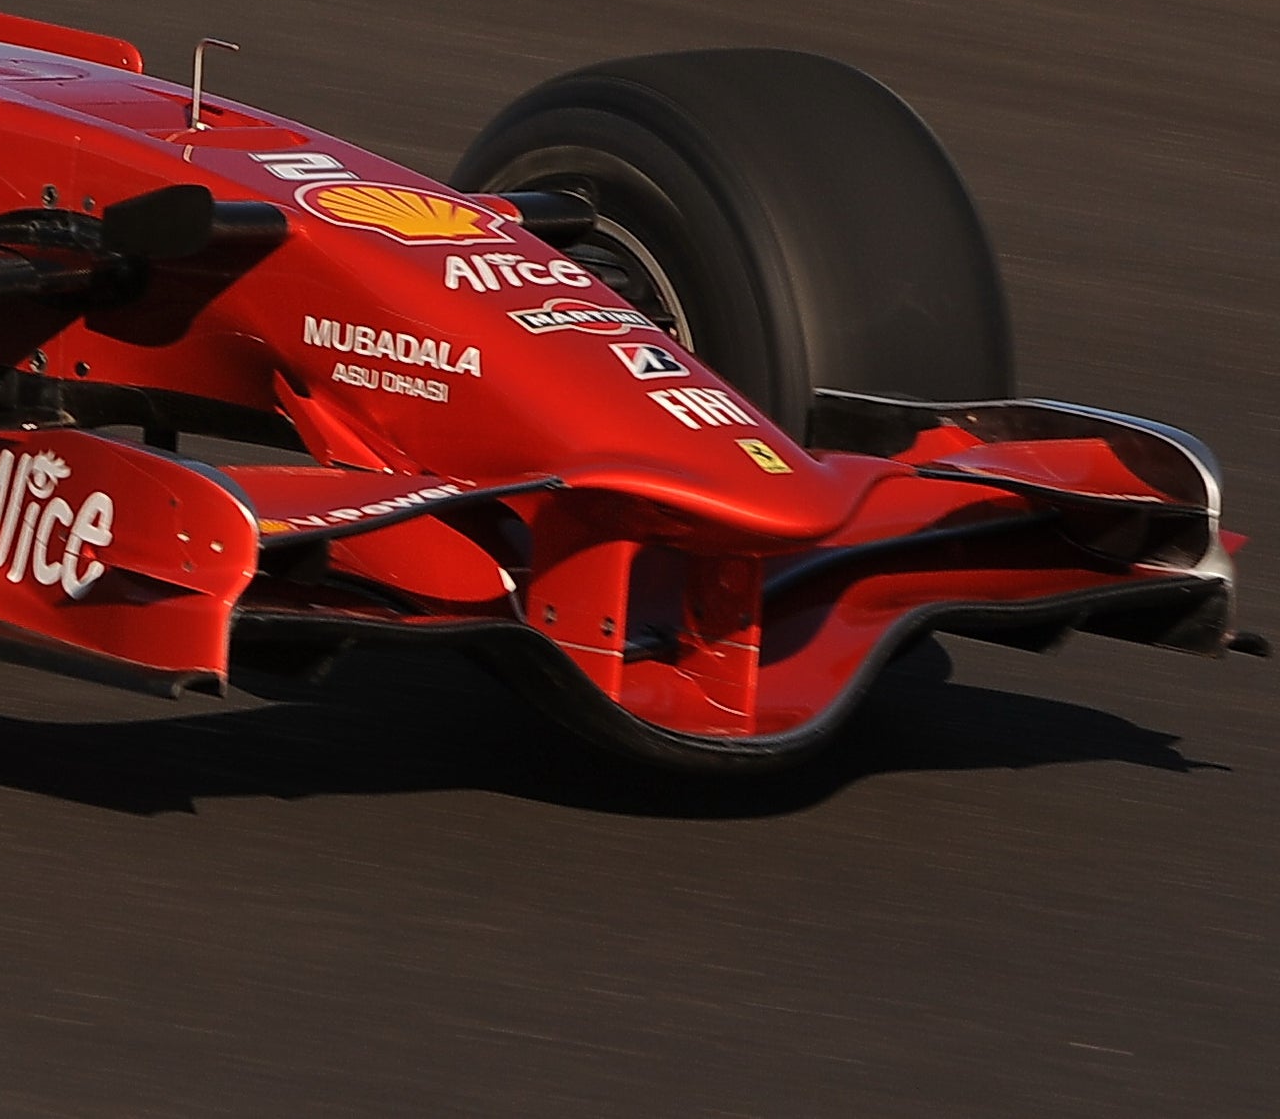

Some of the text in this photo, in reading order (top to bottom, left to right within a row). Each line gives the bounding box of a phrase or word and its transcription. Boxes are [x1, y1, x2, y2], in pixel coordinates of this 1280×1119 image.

[444, 252, 592, 293] Alice
[524, 310, 649, 328] MARTINI
[303, 315, 482, 378] MUBADALA
[646, 387, 760, 430] FIAT
